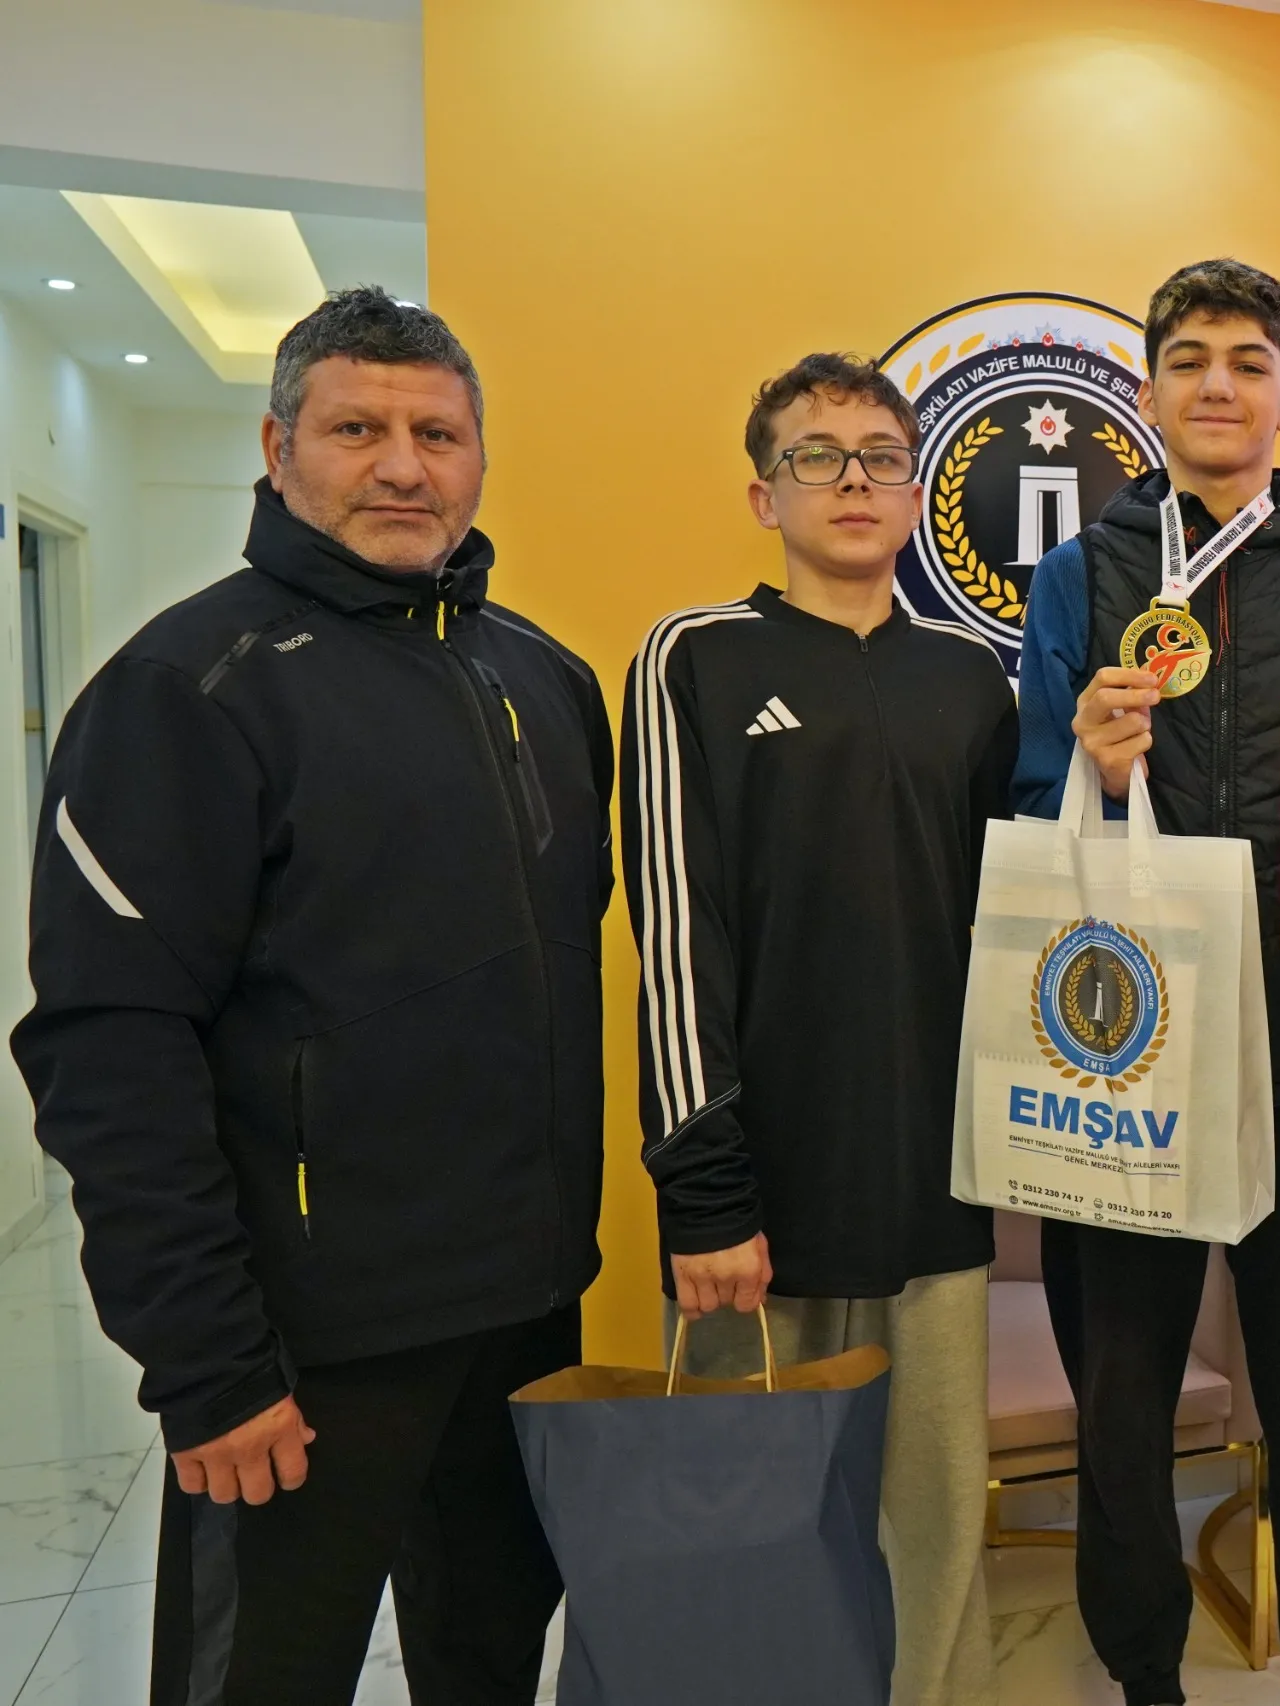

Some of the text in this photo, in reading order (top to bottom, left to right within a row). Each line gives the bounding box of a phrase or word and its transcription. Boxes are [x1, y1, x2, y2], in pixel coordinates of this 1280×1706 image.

[919, 354, 1140, 434] EŞKİLATI VAZİFE MALULÜ VE ŞEH
[273, 633, 313, 652] TRIBORD
[1156, 613, 1204, 647] FEDERASYONU
[1044, 964, 1056, 996] EMNİYET
[1054, 935, 1082, 967] TEŞKİLATI
[1132, 953, 1152, 986] AİLELERİ
[1009, 1085, 1179, 1150] EMŞAV
[1009, 1134, 1035, 1145] EMNİYET
[1035, 1140, 1064, 1152] TEŞKİLATI
[1065, 1146, 1085, 1156] VAZİFE
[1086, 1151, 1110, 1161] MALULÜ
[1163, 1162, 1181, 1170] VAKFI
[1064, 1155, 1090, 1166] GENEL
[1022, 1183, 1084, 1204] 0312 230 74 17
[1107, 1202, 1173, 1220] 0312 230 74 20
